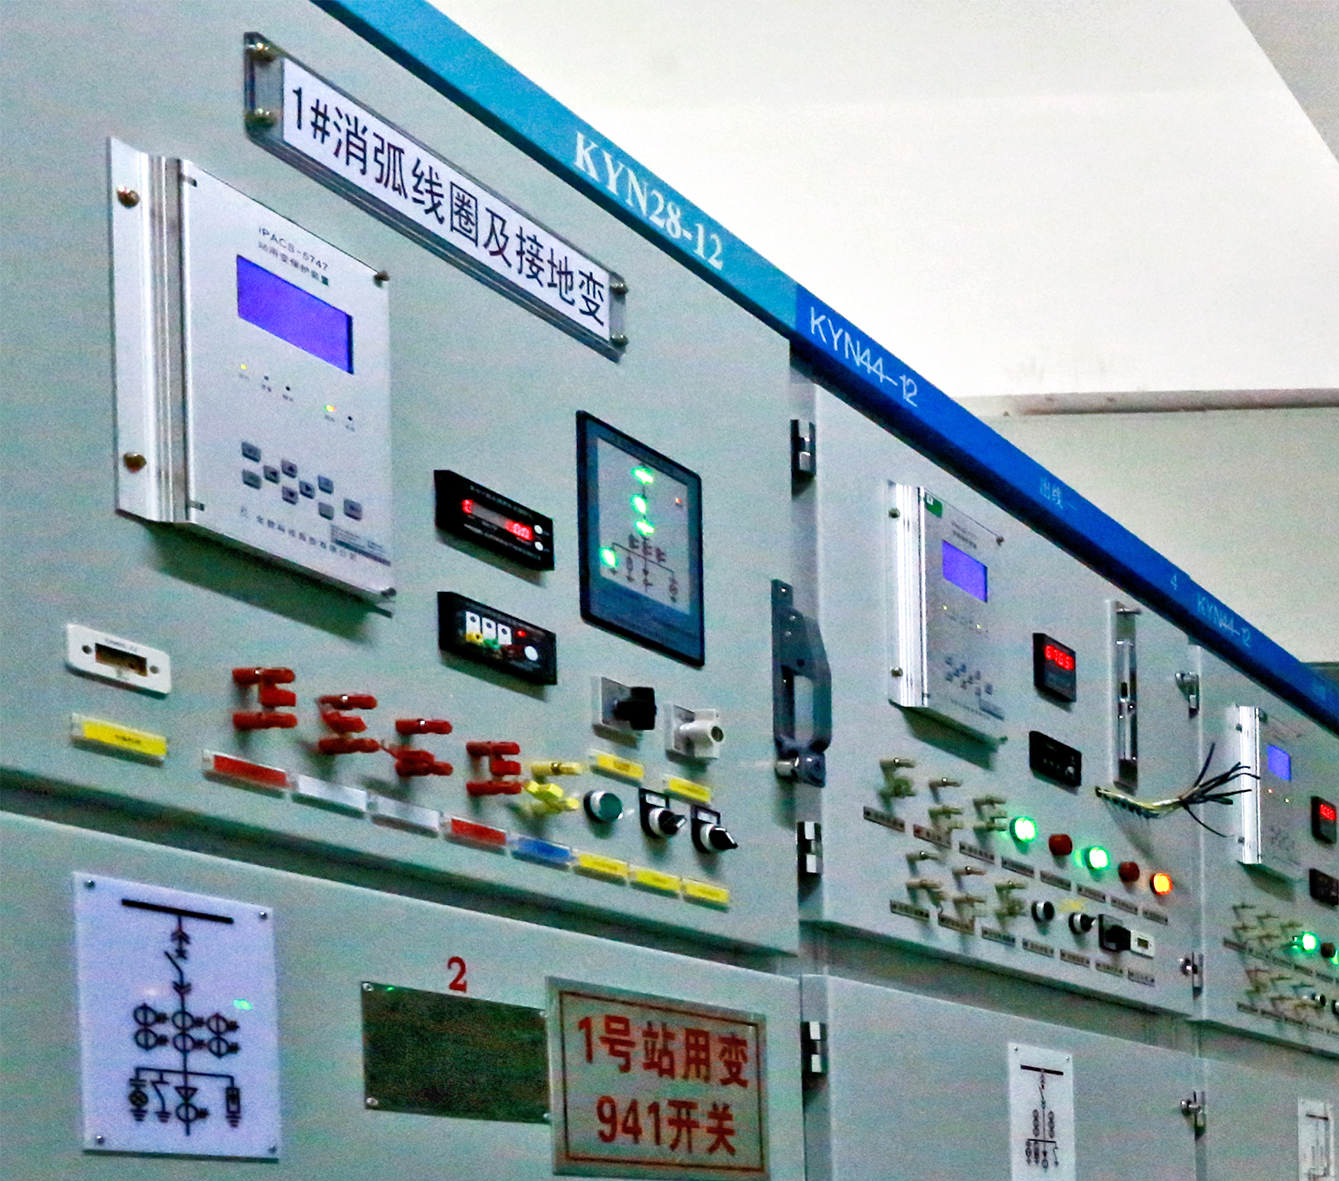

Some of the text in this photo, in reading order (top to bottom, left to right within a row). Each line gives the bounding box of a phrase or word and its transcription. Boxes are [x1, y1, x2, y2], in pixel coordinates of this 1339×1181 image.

[292, 86, 606, 327] 1#消弧线圈及接地变
[573, 131, 724, 270] KYN28-12
[810, 307, 919, 407] KYN44-12
[446, 956, 468, 993] 2
[578, 1015, 749, 1088] 1号站用变
[597, 1096, 737, 1156] 941开关
